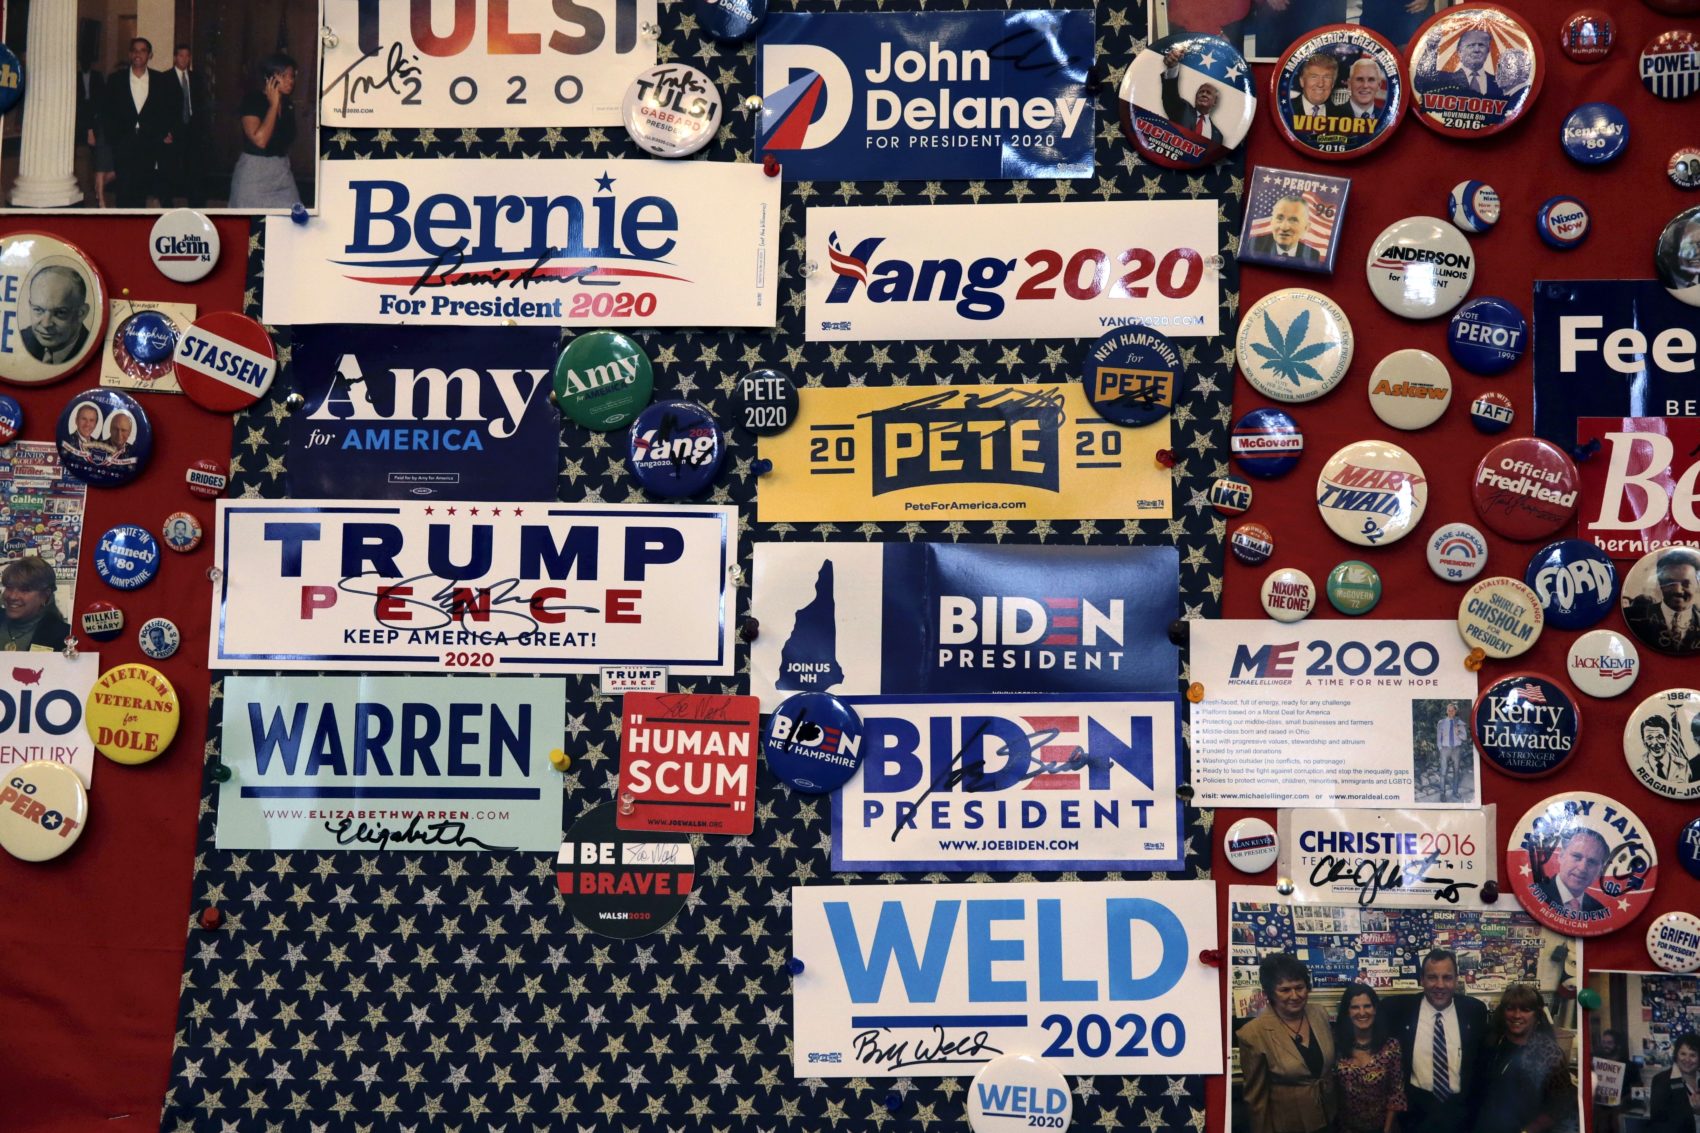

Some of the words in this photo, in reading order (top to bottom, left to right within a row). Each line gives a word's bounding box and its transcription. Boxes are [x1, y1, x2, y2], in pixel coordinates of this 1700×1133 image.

[720, 0, 758, 24] Delaney
[865, 42, 990, 83] John
[1285, 45, 1309, 72] MAKE
[1307, 31, 1349, 57] AMERICA
[1351, 34, 1380, 54] GREAT
[637, 80, 718, 122] TULSI
[1424, 93, 1508, 115] VICTORY
[640, 106, 701, 132] GABBARD
[867, 88, 1087, 139] Delaney
[1293, 115, 1378, 134] VICTORY
[1444, 117, 1482, 130] 2016
[866, 136, 900, 149] FOR
[909, 135, 1001, 148] PRESIDENT
[1012, 134, 1055, 147] 2020
[1136, 118, 1206, 157] VICTORY
[1564, 122, 1623, 138] Kennedy
[1147, 143, 1179, 161] 2016
[1318, 143, 1346, 152] 2016
[1282, 177, 1321, 193] PEROT
[345, 172, 678, 260] Bernie
[1551, 211, 1584, 226] Nixon
[1557, 221, 1582, 234] Now
[155, 236, 210, 255] Glenn
[183, 234, 201, 242] John
[1381, 247, 1470, 269] ANDERSON
[825, 230, 1016, 320] Yang
[1016, 247, 1203, 300] 2020
[1433, 268, 1468, 280] ILLINOIS
[379, 295, 426, 315] For
[431, 296, 562, 318] President
[569, 292, 657, 318] 2020
[1306, 293, 1328, 309] HEMP
[1326, 304, 1343, 322] LADY
[1460, 311, 1479, 320] VOTE
[125, 326, 169, 344] Humphrey
[1456, 323, 1520, 348] PEROT
[180, 335, 268, 389] STASSEN
[1094, 338, 1118, 362] NEW
[1120, 333, 1179, 368] HAMPSHIRE
[1126, 353, 1144, 363] for
[1497, 351, 1516, 361] 1996
[562, 354, 640, 398] Amy
[1101, 372, 1168, 400] PETE
[306, 354, 549, 438] Amy
[744, 378, 786, 401] PETE
[1372, 379, 1449, 400] Askew
[745, 406, 787, 428] 2020
[1475, 401, 1512, 421] TAFT
[305, 429, 335, 449] for
[341, 429, 484, 450] AMERICA
[632, 430, 716, 466] Yang
[810, 437, 855, 462] 20
[885, 419, 1046, 478] PETE
[1076, 430, 1121, 455] 20
[1238, 438, 1299, 449] McGovern
[200, 463, 217, 471] VOTE
[1500, 458, 1562, 484] Official
[190, 472, 224, 487] BRIDGES
[1331, 464, 1425, 498] MARK
[1479, 468, 1578, 508] FredHead
[10, 495, 43, 504] Gallen
[905, 501, 1026, 511] PeteForAmerica.com
[1213, 487, 1250, 510] IKE
[1319, 484, 1417, 517] TWAIN
[1361, 517, 1385, 544] '92
[101, 540, 156, 563] Kennedy
[263, 522, 685, 582] TRUMP
[1433, 531, 1454, 551] JESSE
[1455, 530, 1484, 555] JACKSON
[96, 559, 110, 576] NEW
[109, 568, 151, 588] HAMPSHIRE
[114, 557, 135, 571] '80
[1440, 559, 1475, 568] PRESIDENT
[1272, 581, 1309, 598] NIXON'S
[1535, 558, 1616, 614] FORD
[300, 585, 642, 625] PENCE
[1268, 594, 1286, 608] THE
[1287, 598, 1310, 612] ONE!
[1473, 579, 1510, 594] CATALYST
[1526, 590, 1541, 624] CHANGE
[1489, 593, 1527, 617] SHIRLEY
[84, 611, 119, 623] WILLKIE
[939, 596, 1124, 646] BIDEN
[1467, 598, 1533, 641] CHISHOLM
[344, 629, 399, 645] KEEP
[407, 629, 509, 646] AMERICA
[518, 630, 597, 648] GREAT!
[1466, 623, 1513, 654] PRESIDENT
[445, 651, 495, 668] 2020
[787, 663, 814, 673] JOIN
[815, 663, 830, 673] US
[939, 650, 1124, 670] PRESIDENT
[1306, 640, 1440, 676] 2020
[100, 667, 170, 697] VIETNAM
[606, 671, 662, 679] TRUMP
[800, 674, 817, 683] NH
[94, 692, 173, 713] VETERANS
[1667, 693, 1692, 701] 1984
[123, 713, 138, 726] for
[1488, 696, 1564, 732] Kerry
[97, 727, 159, 752] DOLE
[247, 702, 531, 777] WARREN
[628, 729, 750, 757] HUMAN
[1483, 725, 1571, 751] Edwards
[794, 746, 856, 769] HAMPSHIRE
[863, 715, 1154, 793] BIDEN
[1505, 759, 1547, 768] AMERICA
[10, 777, 37, 795] GO
[627, 759, 748, 797] SCUM
[0, 786, 80, 838] PEROT
[263, 810, 510, 820] WWW.ELIZABETHWARREN.COM
[647, 819, 723, 828] WWW.JOEWALSH.ORG
[863, 800, 1154, 829] PRESIDENT
[580, 843, 616, 865] BE
[939, 840, 1079, 851] WWW.JOEBIDEN.COM
[1244, 847, 1276, 856] PRESIDENT
[580, 872, 671, 895] BRAVE
[1529, 883, 1547, 904] FOR
[1549, 900, 1612, 922] PRESIDENT
[1434, 912, 1455, 920] BUSH
[1539, 907, 1588, 929] REPUBLICAN
[1660, 926, 1700, 949] GRIFFIN
[823, 898, 1189, 1003] WELD
[1041, 1013, 1186, 1058] 2020
[977, 1083, 1067, 1114] WELD
[1028, 1115, 1065, 1128] 2020
